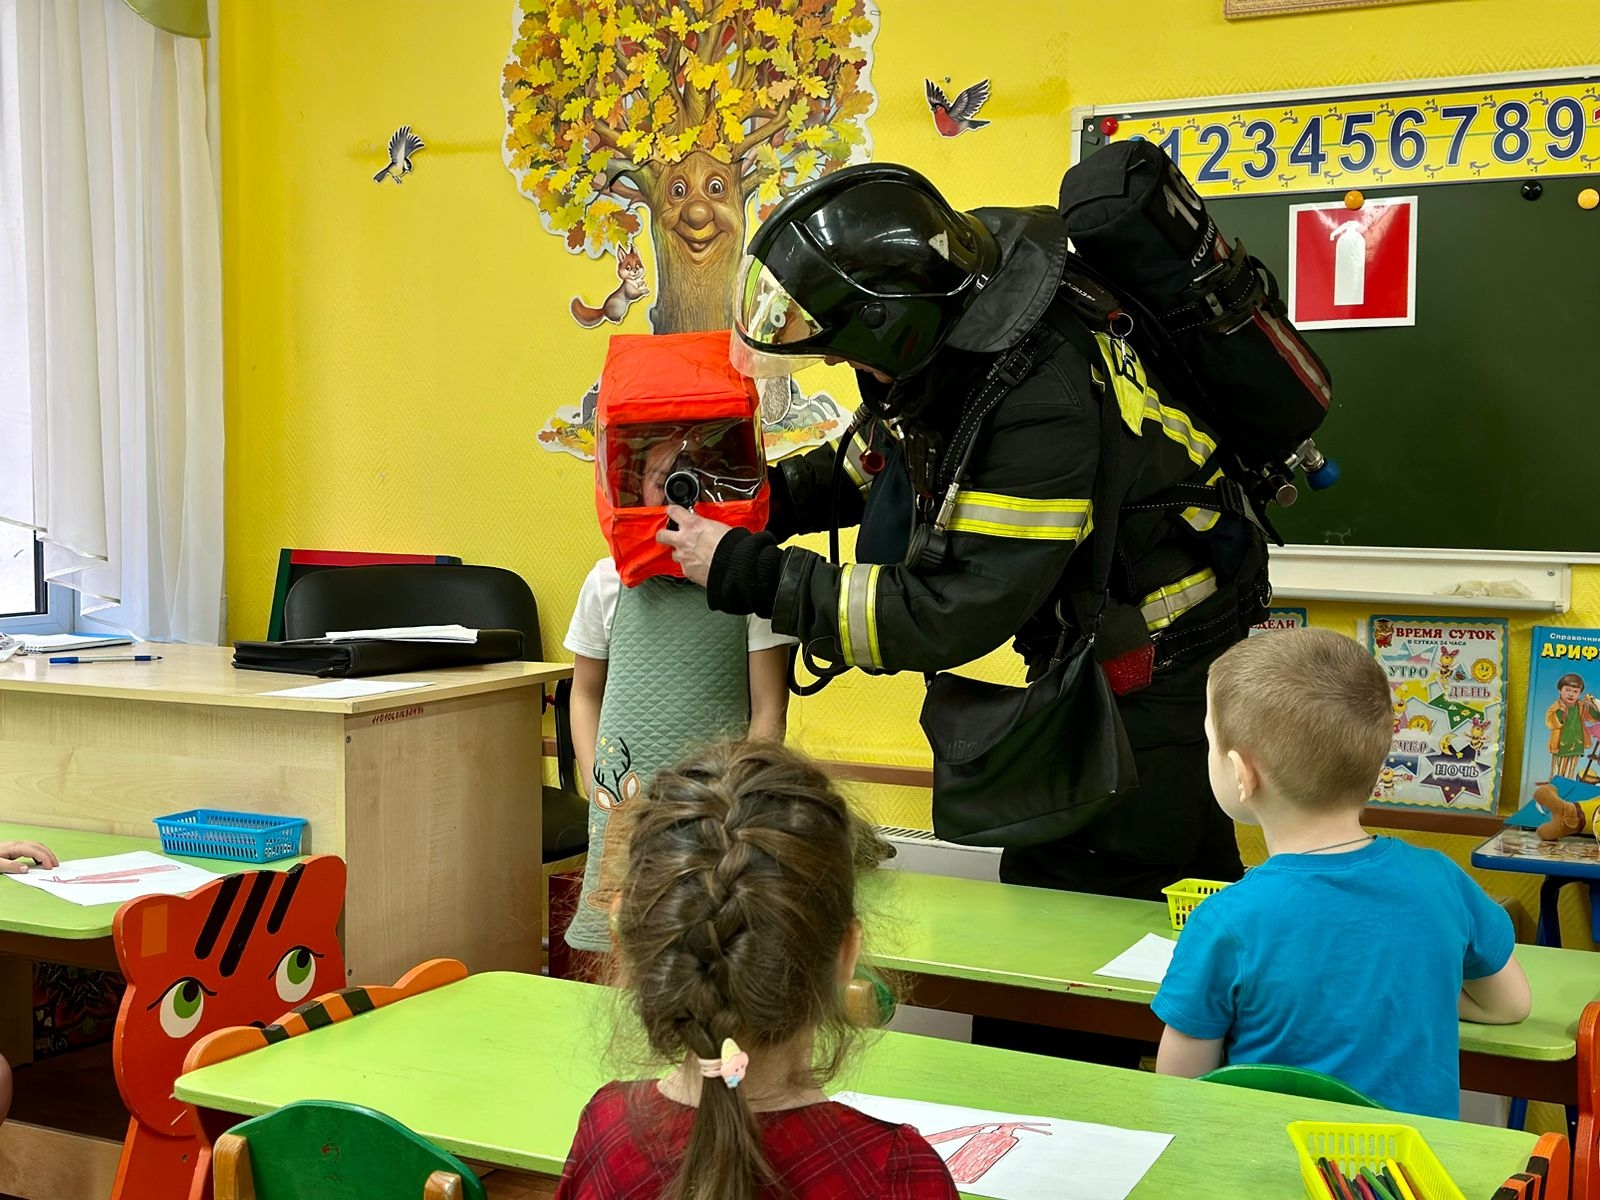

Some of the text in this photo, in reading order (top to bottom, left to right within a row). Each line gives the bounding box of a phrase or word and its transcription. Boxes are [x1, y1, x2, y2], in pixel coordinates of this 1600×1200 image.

[1197, 124, 1231, 183] 2
[1243, 120, 1276, 179] 3
[1289, 116, 1327, 175] 4
[1339, 112, 1375, 172] 5
[1389, 109, 1427, 169] 6
[1441, 105, 1479, 166] 7
[1492, 101, 1530, 163] 8
[1546, 97, 1586, 160] 9
[1249, 619, 1296, 630] ДЕЛИ
[1396, 627, 1496, 640] ВРЕМЯ СУТОК
[1541, 642, 1600, 661] АРИФ
[1388, 666, 1429, 678] УТРО
[1449, 685, 1492, 698] ДЕНЬ
[1435, 763, 1479, 778] НОЧЬ
